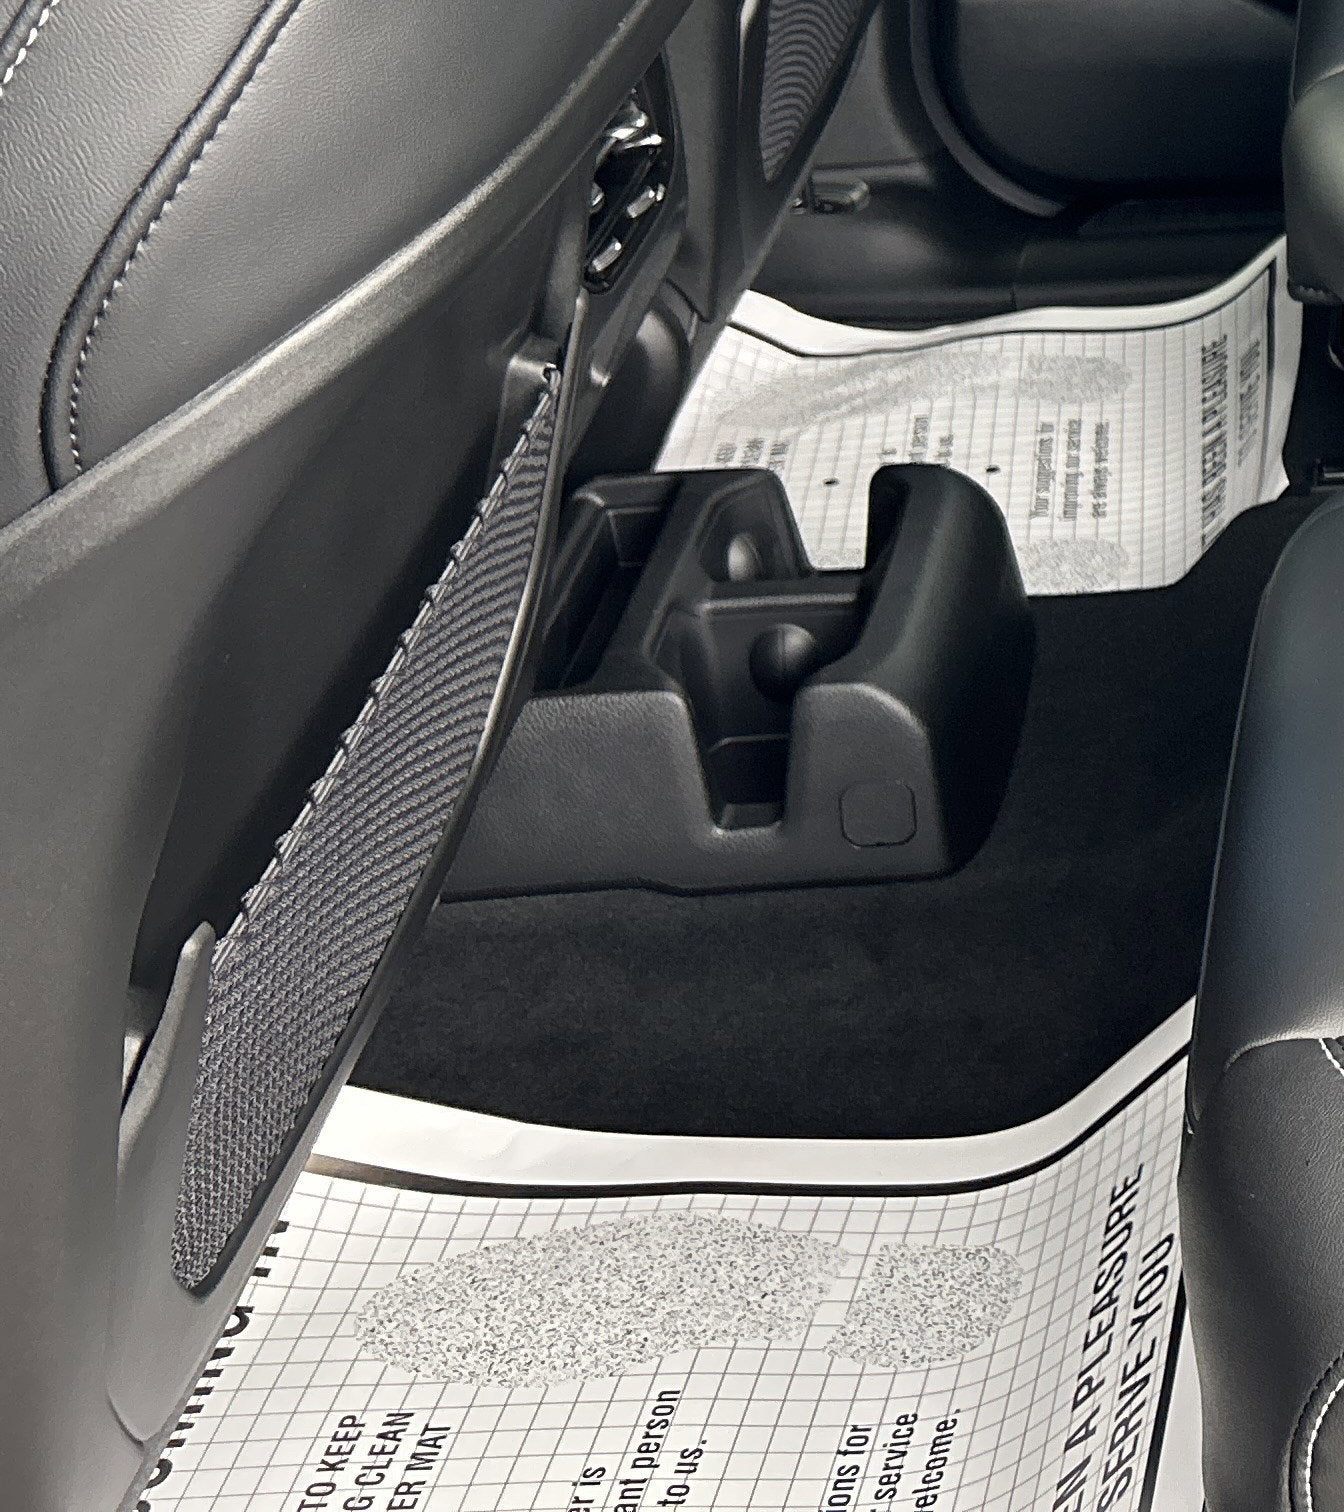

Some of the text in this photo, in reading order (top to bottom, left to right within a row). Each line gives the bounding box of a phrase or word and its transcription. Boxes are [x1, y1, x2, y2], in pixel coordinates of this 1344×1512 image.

[1201, 334, 1227, 425] PLEASURE
[1201, 430, 1227, 488] BEEN
[1072, 1163, 1144, 1413] PLEASURE
[1098, 1233, 1175, 1512] SERVE YOU
[298, 1414, 366, 1512] TO KEEP
[354, 1411, 415, 1486] CLEAN
[405, 1424, 451, 1471] MAT
[631, 1389, 681, 1469] person
[837, 1424, 873, 1458] for
[874, 1412, 919, 1500] service
[1064, 1404, 1100, 1454] A
[571, 1466, 606, 1486] is
[657, 1439, 708, 1509] to us.
